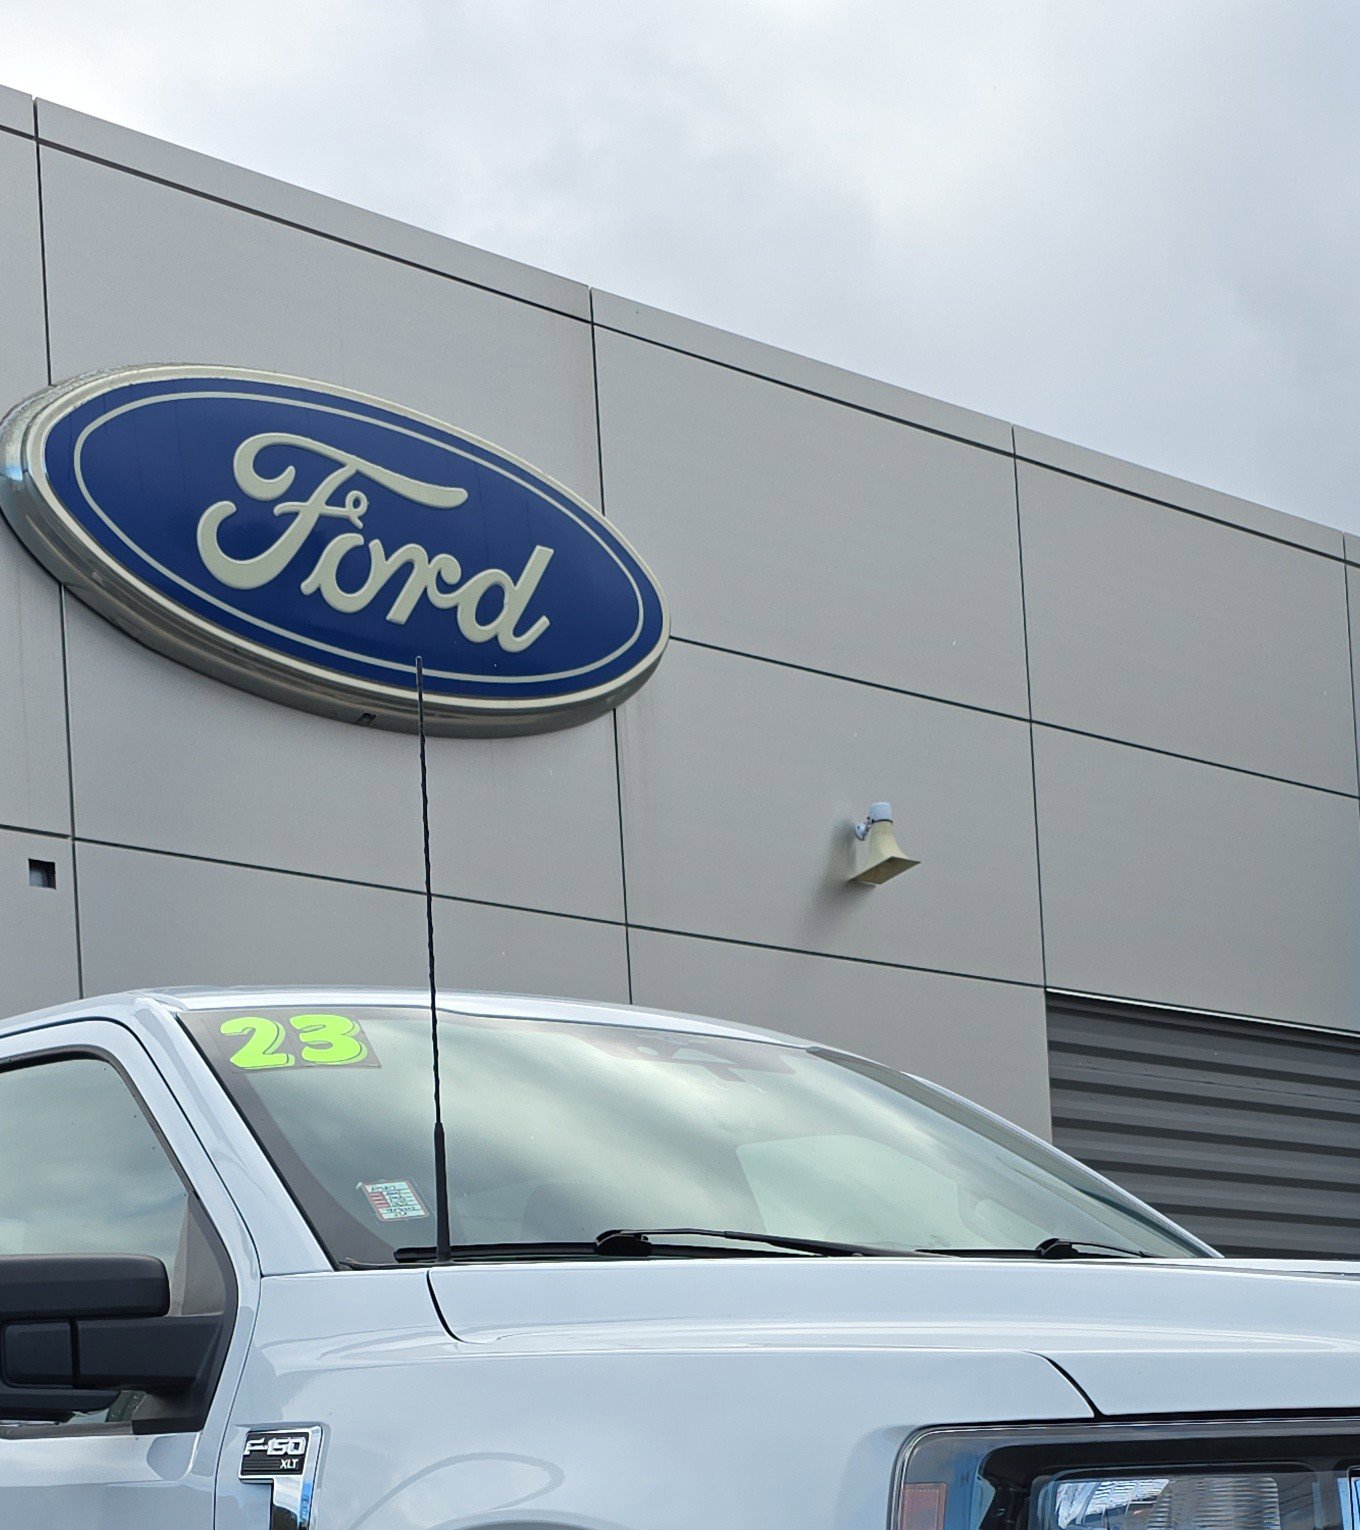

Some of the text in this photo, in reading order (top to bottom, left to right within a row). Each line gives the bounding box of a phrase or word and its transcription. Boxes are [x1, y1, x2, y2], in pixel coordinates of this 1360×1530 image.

[197, 432, 554, 652] Ford
[220, 1014, 368, 1070] 23
[243, 1437, 308, 1455] F-150
[279, 1458, 299, 1469] XLT
